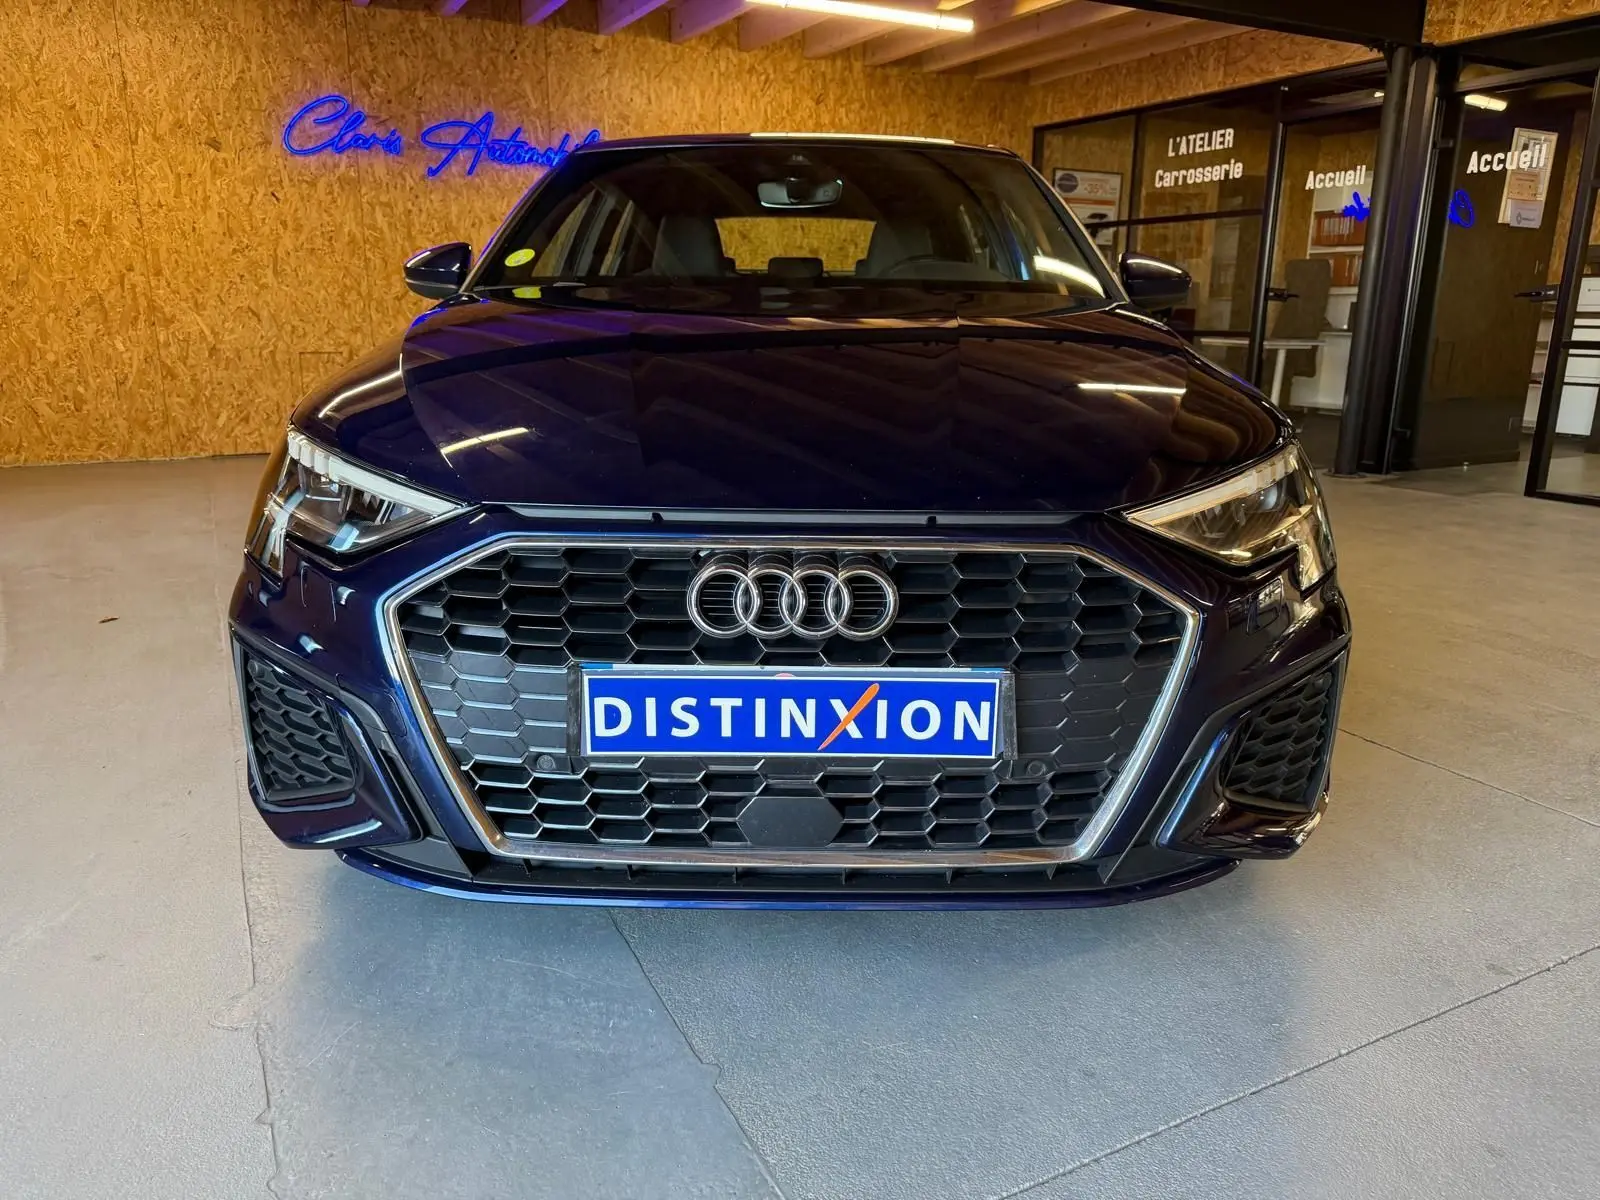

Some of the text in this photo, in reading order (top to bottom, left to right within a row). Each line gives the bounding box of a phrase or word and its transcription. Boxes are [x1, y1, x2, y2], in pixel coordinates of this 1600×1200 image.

[283, 95, 402, 155] Claris
[1168, 128, 1234, 157] L'ATELIER
[1155, 158, 1243, 188] Carrosserie
[1466, 143, 1547, 174] Accueil
[1305, 164, 1367, 190] Accueil
[593, 683, 991, 750] DISTINXION
